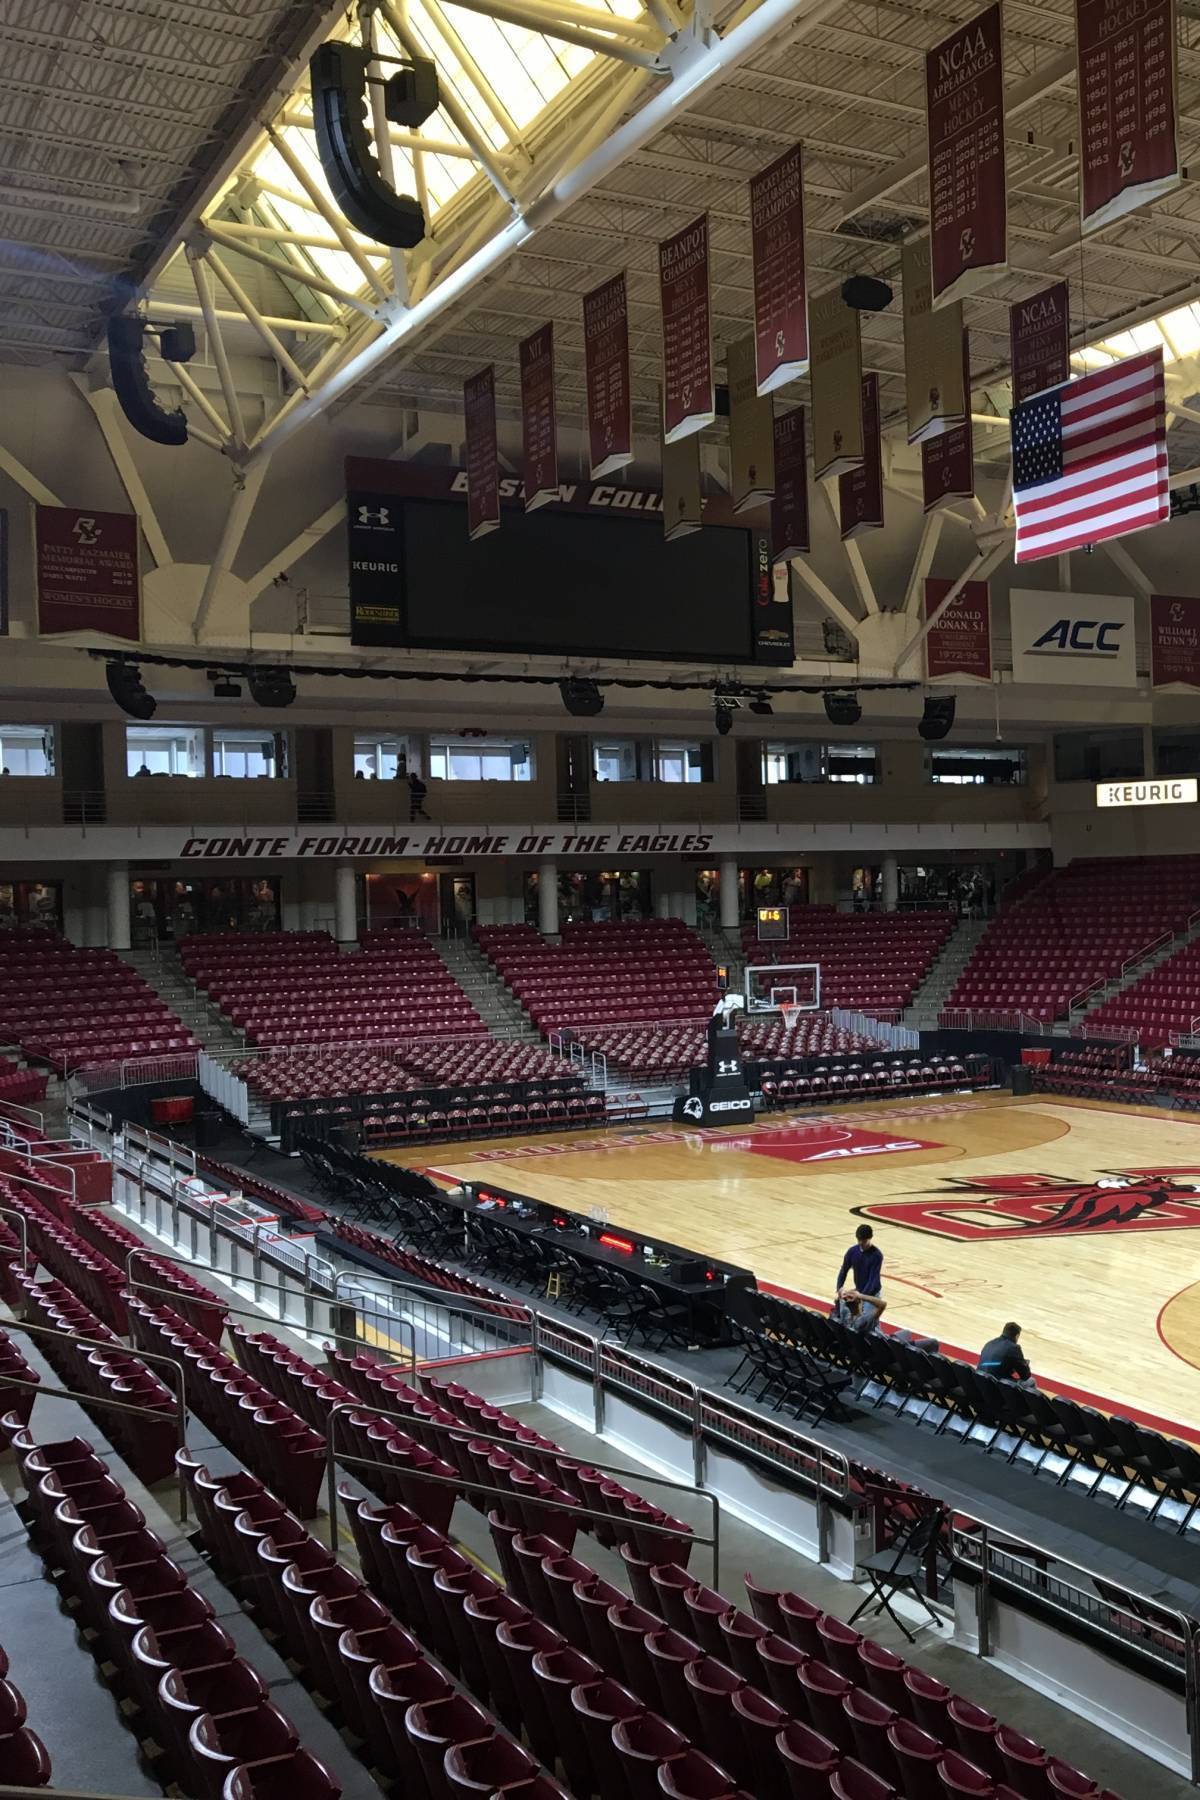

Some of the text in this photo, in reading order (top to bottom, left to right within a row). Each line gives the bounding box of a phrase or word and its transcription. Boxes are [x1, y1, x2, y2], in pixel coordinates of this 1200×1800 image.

[939, 26, 986, 80] NCAA
[1086, 51, 1107, 69] 1948
[933, 48, 994, 101] APPEARANCES
[1086, 68, 1107, 86] 1949
[949, 82, 978, 111] MEN'S
[1086, 86, 1107, 103] 1950
[944, 97, 984, 135] HOCKEY
[1087, 103, 1108, 119] 1954
[1087, 121, 1108, 137] 1956
[1088, 137, 1109, 153] 1959
[753, 185, 800, 228] CHAMPIONS
[661, 223, 705, 268] BEANPOT
[663, 247, 705, 281] CHAMPIONS
[1021, 296, 1057, 327] NCAA
[41, 553, 134, 569] MEMORIAL AWARD
[42, 544, 131, 560] PATTY KAZMAIER
[352, 561, 399, 573] KEURIG
[42, 591, 133, 607] WOMEN'S HOCKEY
[943, 610, 981, 620] DONALD
[1032, 620, 1125, 651] ACC
[1158, 626, 1191, 636] WILLIAM
[1158, 635, 1185, 646] FLYNN
[1109, 783, 1182, 802] KEURIG
[180, 838, 290, 857] CONTE
[516, 836, 554, 853] OF
[561, 835, 611, 853] THE
[617, 835, 714, 852] EAGLES
[709, 1099, 751, 1112] GEICO
[799, 1140, 923, 1162] ACC
